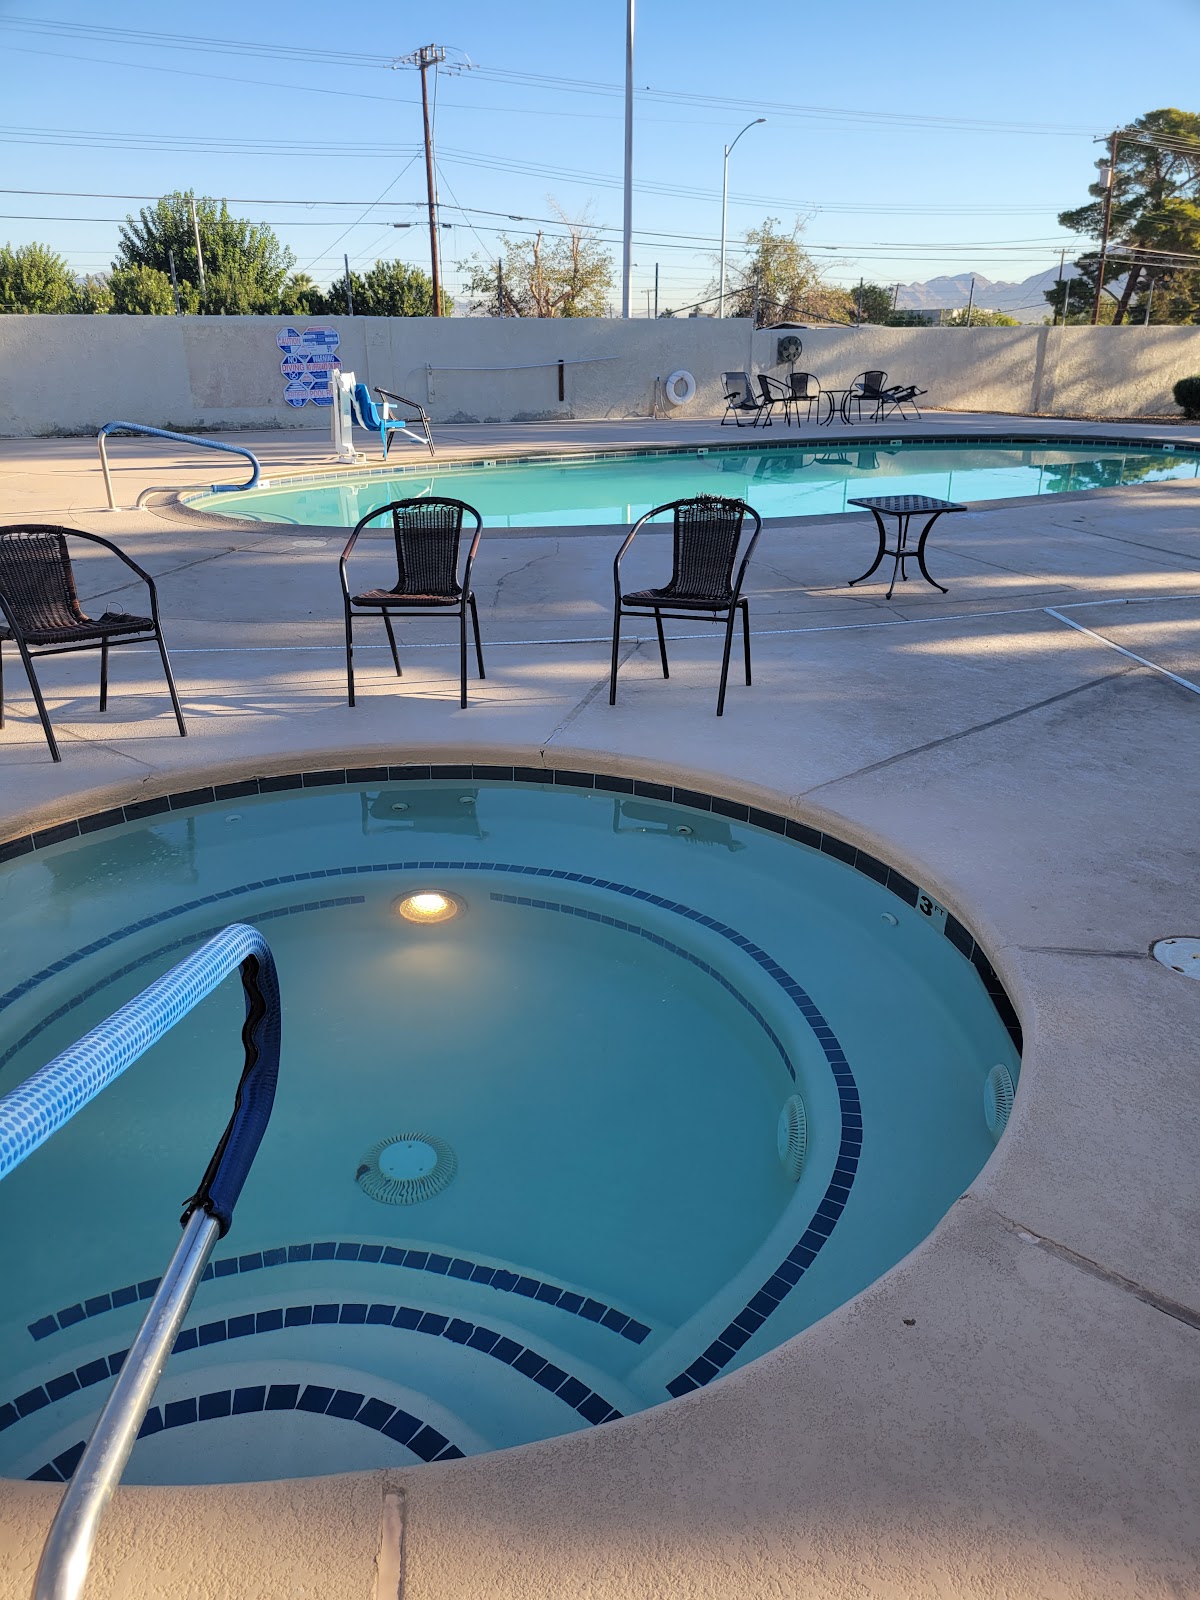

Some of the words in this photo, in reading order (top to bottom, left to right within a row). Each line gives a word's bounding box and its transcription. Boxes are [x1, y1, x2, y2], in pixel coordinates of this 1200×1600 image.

[287, 355, 297, 363] NO
[920, 896, 933, 916] 3
[935, 906, 944, 916] FT
